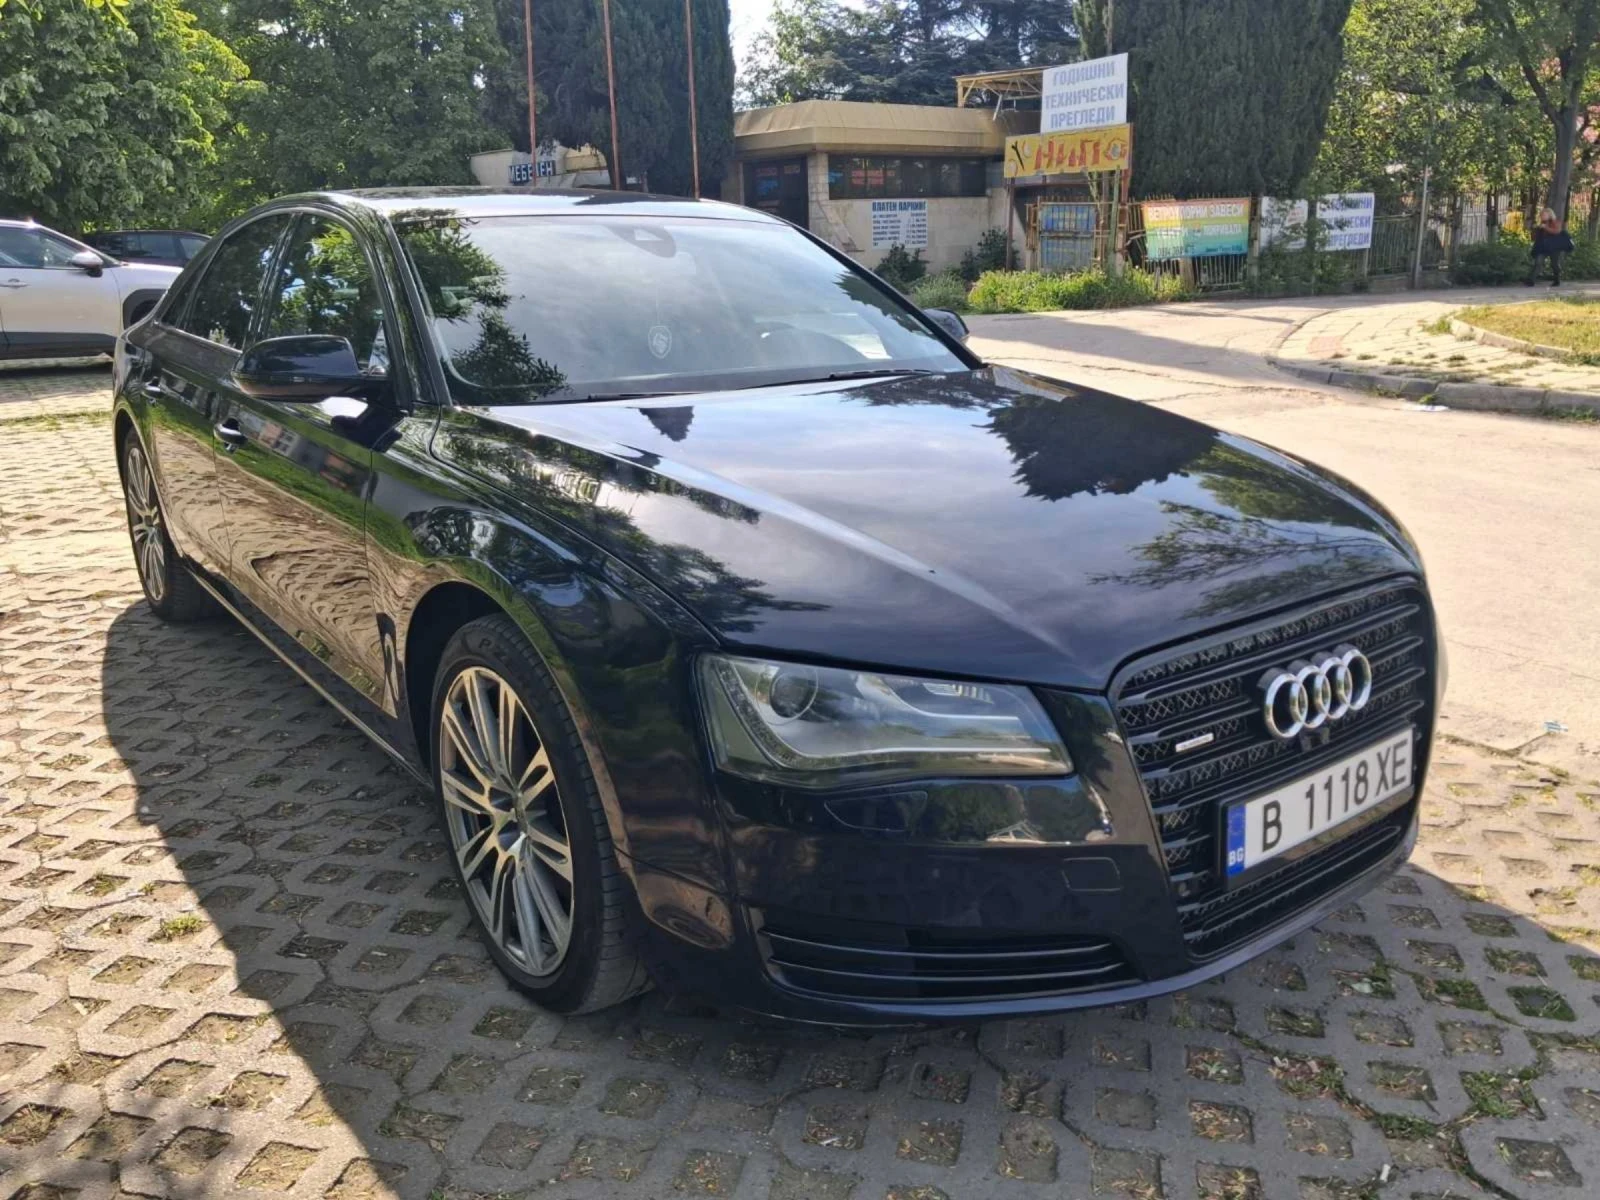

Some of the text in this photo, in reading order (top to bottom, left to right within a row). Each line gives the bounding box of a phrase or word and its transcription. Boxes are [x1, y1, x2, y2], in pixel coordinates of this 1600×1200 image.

[1053, 60, 1115, 86] ГОДИШНИ
[1045, 83, 1124, 109] ТЕХНИЧЕСКИ
[1050, 105, 1115, 128] ПРЕГЛЕДИ
[872, 201, 926, 212] ПЛАТЕН ПАРКИНГ
[1262, 800, 1282, 852] B
[1228, 847, 1244, 864] BG
